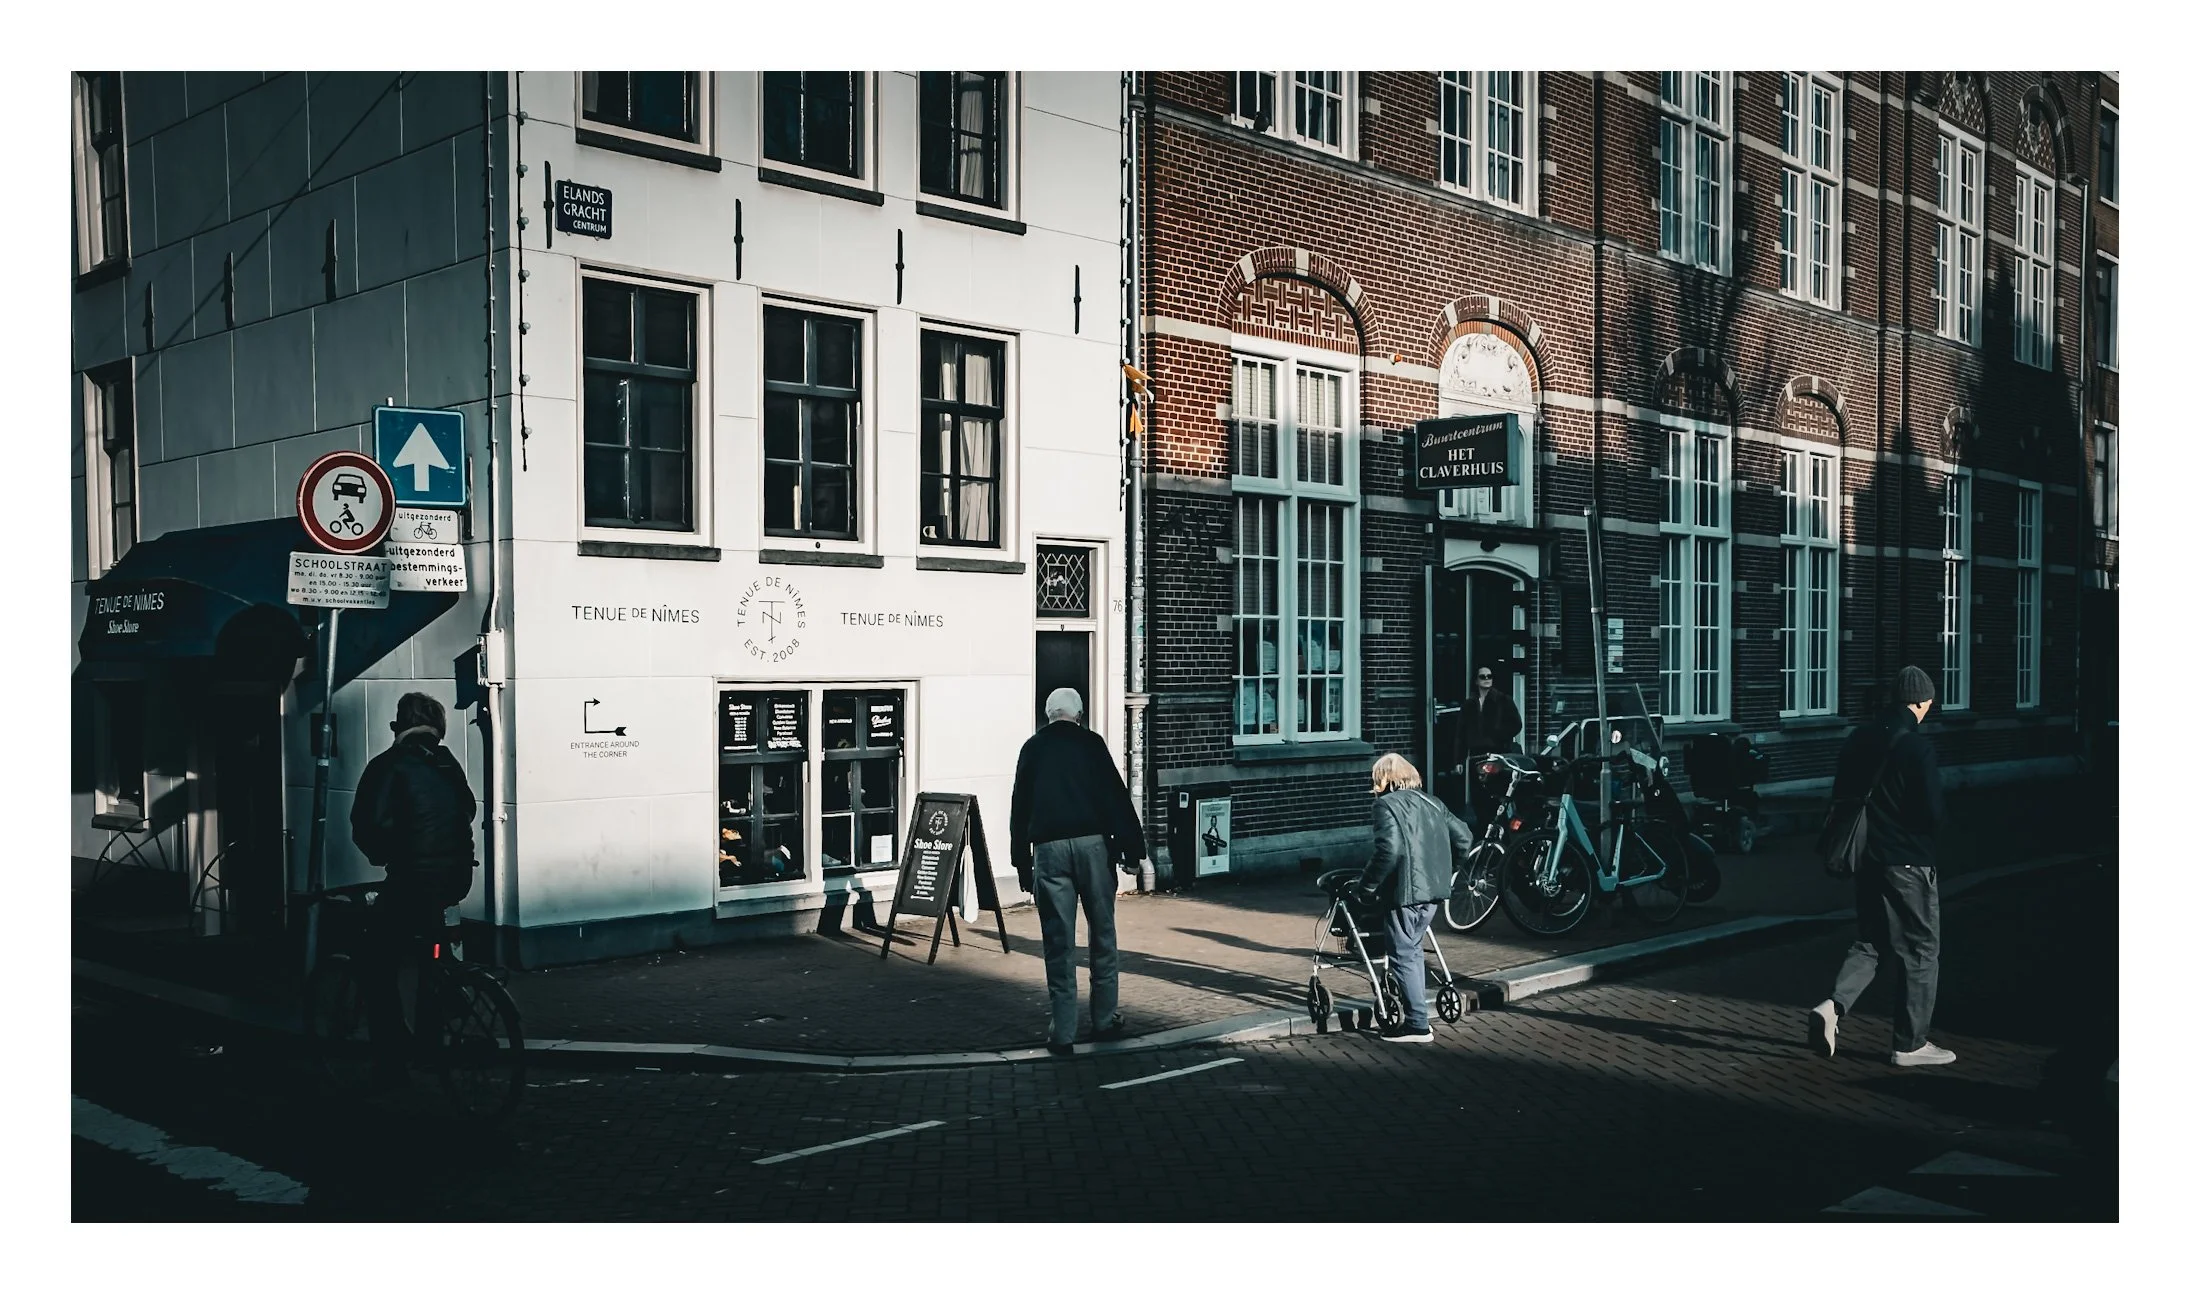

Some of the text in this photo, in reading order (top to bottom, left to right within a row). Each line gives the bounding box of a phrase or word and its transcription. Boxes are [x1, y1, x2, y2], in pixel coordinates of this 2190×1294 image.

[563, 185, 605, 205] ELANDS
[563, 202, 607, 222] GRACHT
[572, 220, 607, 233] CENTRUM
[1421, 421, 1503, 448] Buurtcentrum
[1448, 447, 1475, 461] HET
[1419, 461, 1504, 479] CLAVERHUIS
[398, 511, 452, 522] uitgezonderd
[295, 558, 388, 572] SCHOOLSTRAAT
[425, 577, 464, 587] verkeer
[95, 595, 122, 614] TENUE
[123, 595, 133, 608] DE
[737, 580, 761, 627] TENUE
[765, 576, 782, 588] DE
[1113, 599, 1123, 612] 76
[571, 604, 700, 624] TENUE DE NÎMES
[840, 609, 944, 628] TENUE DE NÎMES
[107, 619, 140, 634] Shoe Store
[570, 740, 640, 750] ENTRANCE AROUND
[599, 750, 628, 758] CORNER
[914, 838, 953, 851] Shoe Store
